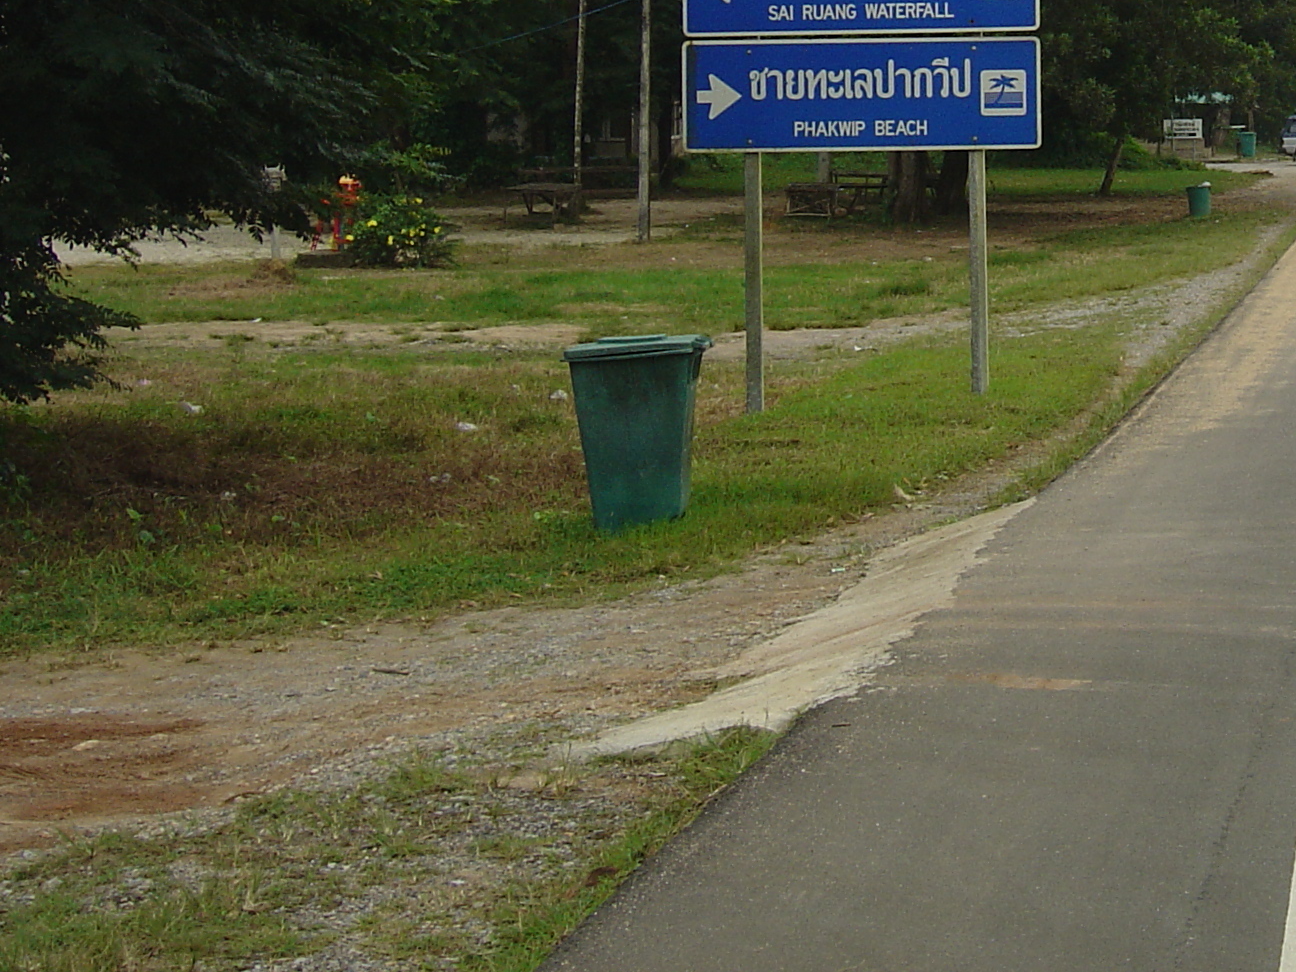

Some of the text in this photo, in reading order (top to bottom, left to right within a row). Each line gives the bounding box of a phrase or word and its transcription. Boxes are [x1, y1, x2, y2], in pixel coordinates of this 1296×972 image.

[768, 1, 955, 21] SAI RUANG WATERFALL
[749, 56, 971, 101] ชายทะเลปากวีป
[793, 119, 928, 138] PHAKWIP BEACH
